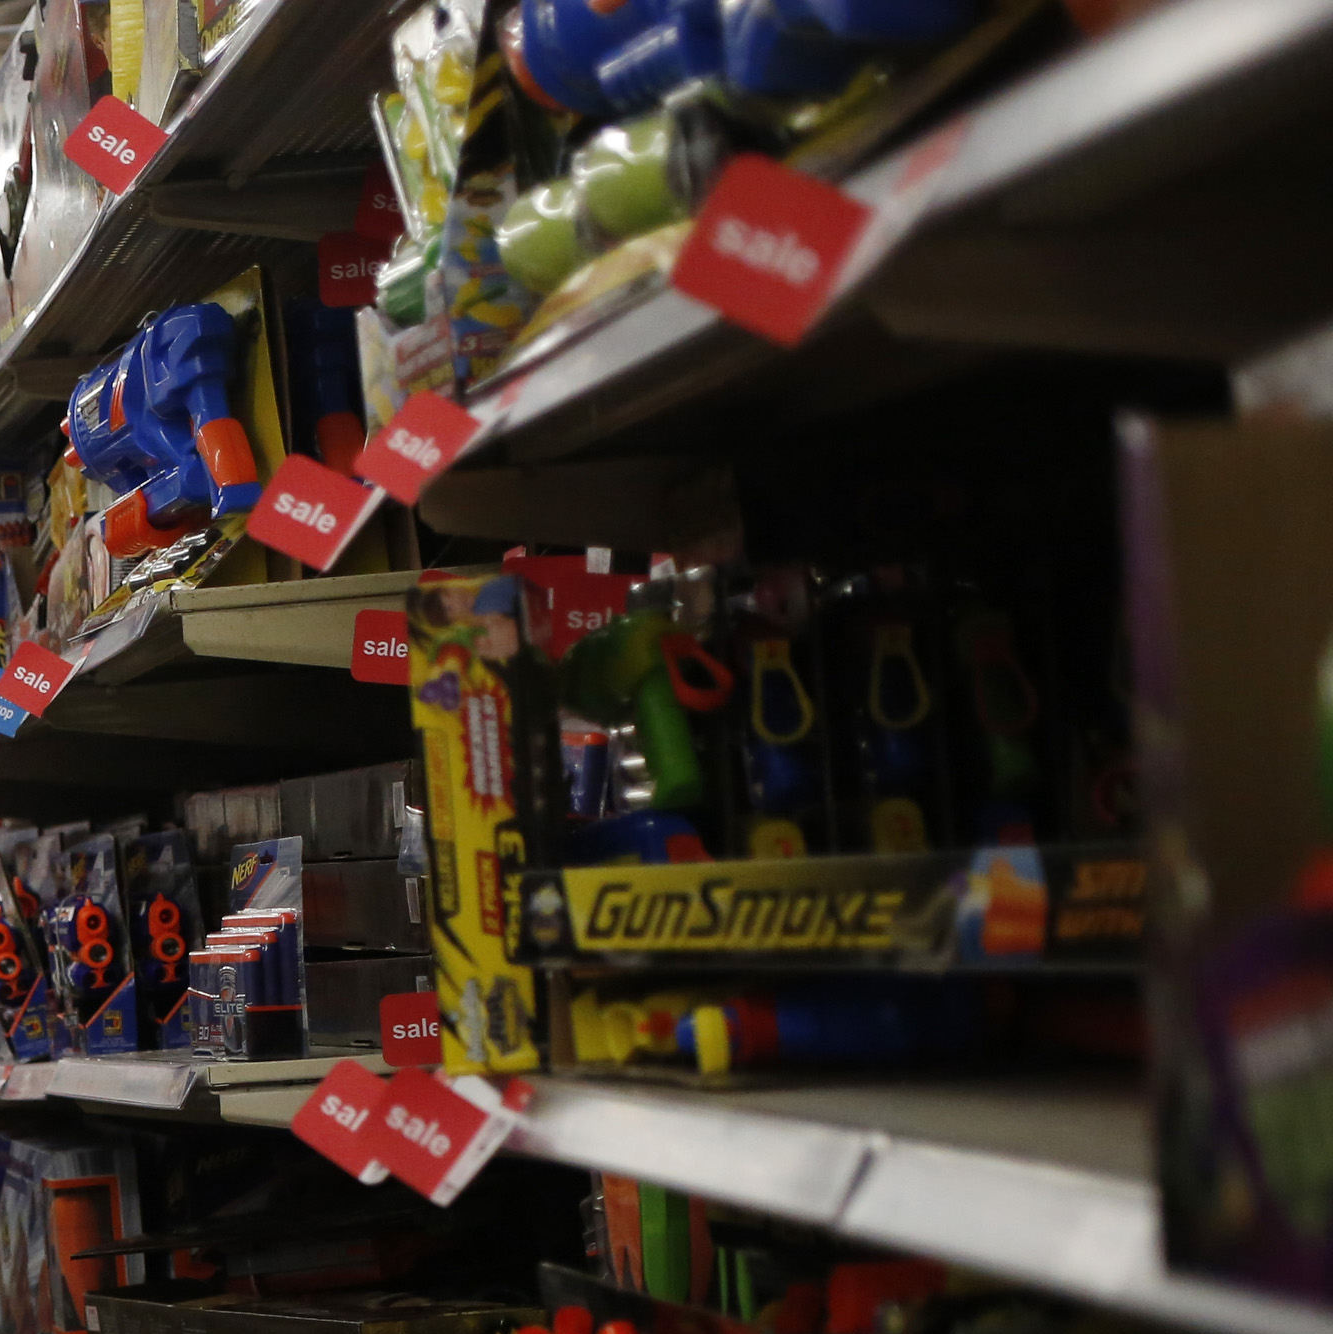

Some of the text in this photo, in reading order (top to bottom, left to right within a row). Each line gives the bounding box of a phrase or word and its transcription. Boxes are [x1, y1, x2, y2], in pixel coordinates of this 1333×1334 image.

[87, 124, 136, 165] sale
[330, 260, 379, 280] sale
[709, 215, 821, 288] sale
[386, 427, 442, 470] sale
[273, 491, 337, 535] sale
[364, 637, 409, 658] sale
[13, 664, 52, 694] sale
[230, 854, 259, 890] NERF
[214, 1002, 244, 1014] ELITE
[392, 1016, 440, 1041] sale
[320, 1093, 370, 1132] sal
[384, 1103, 452, 1157] sale
